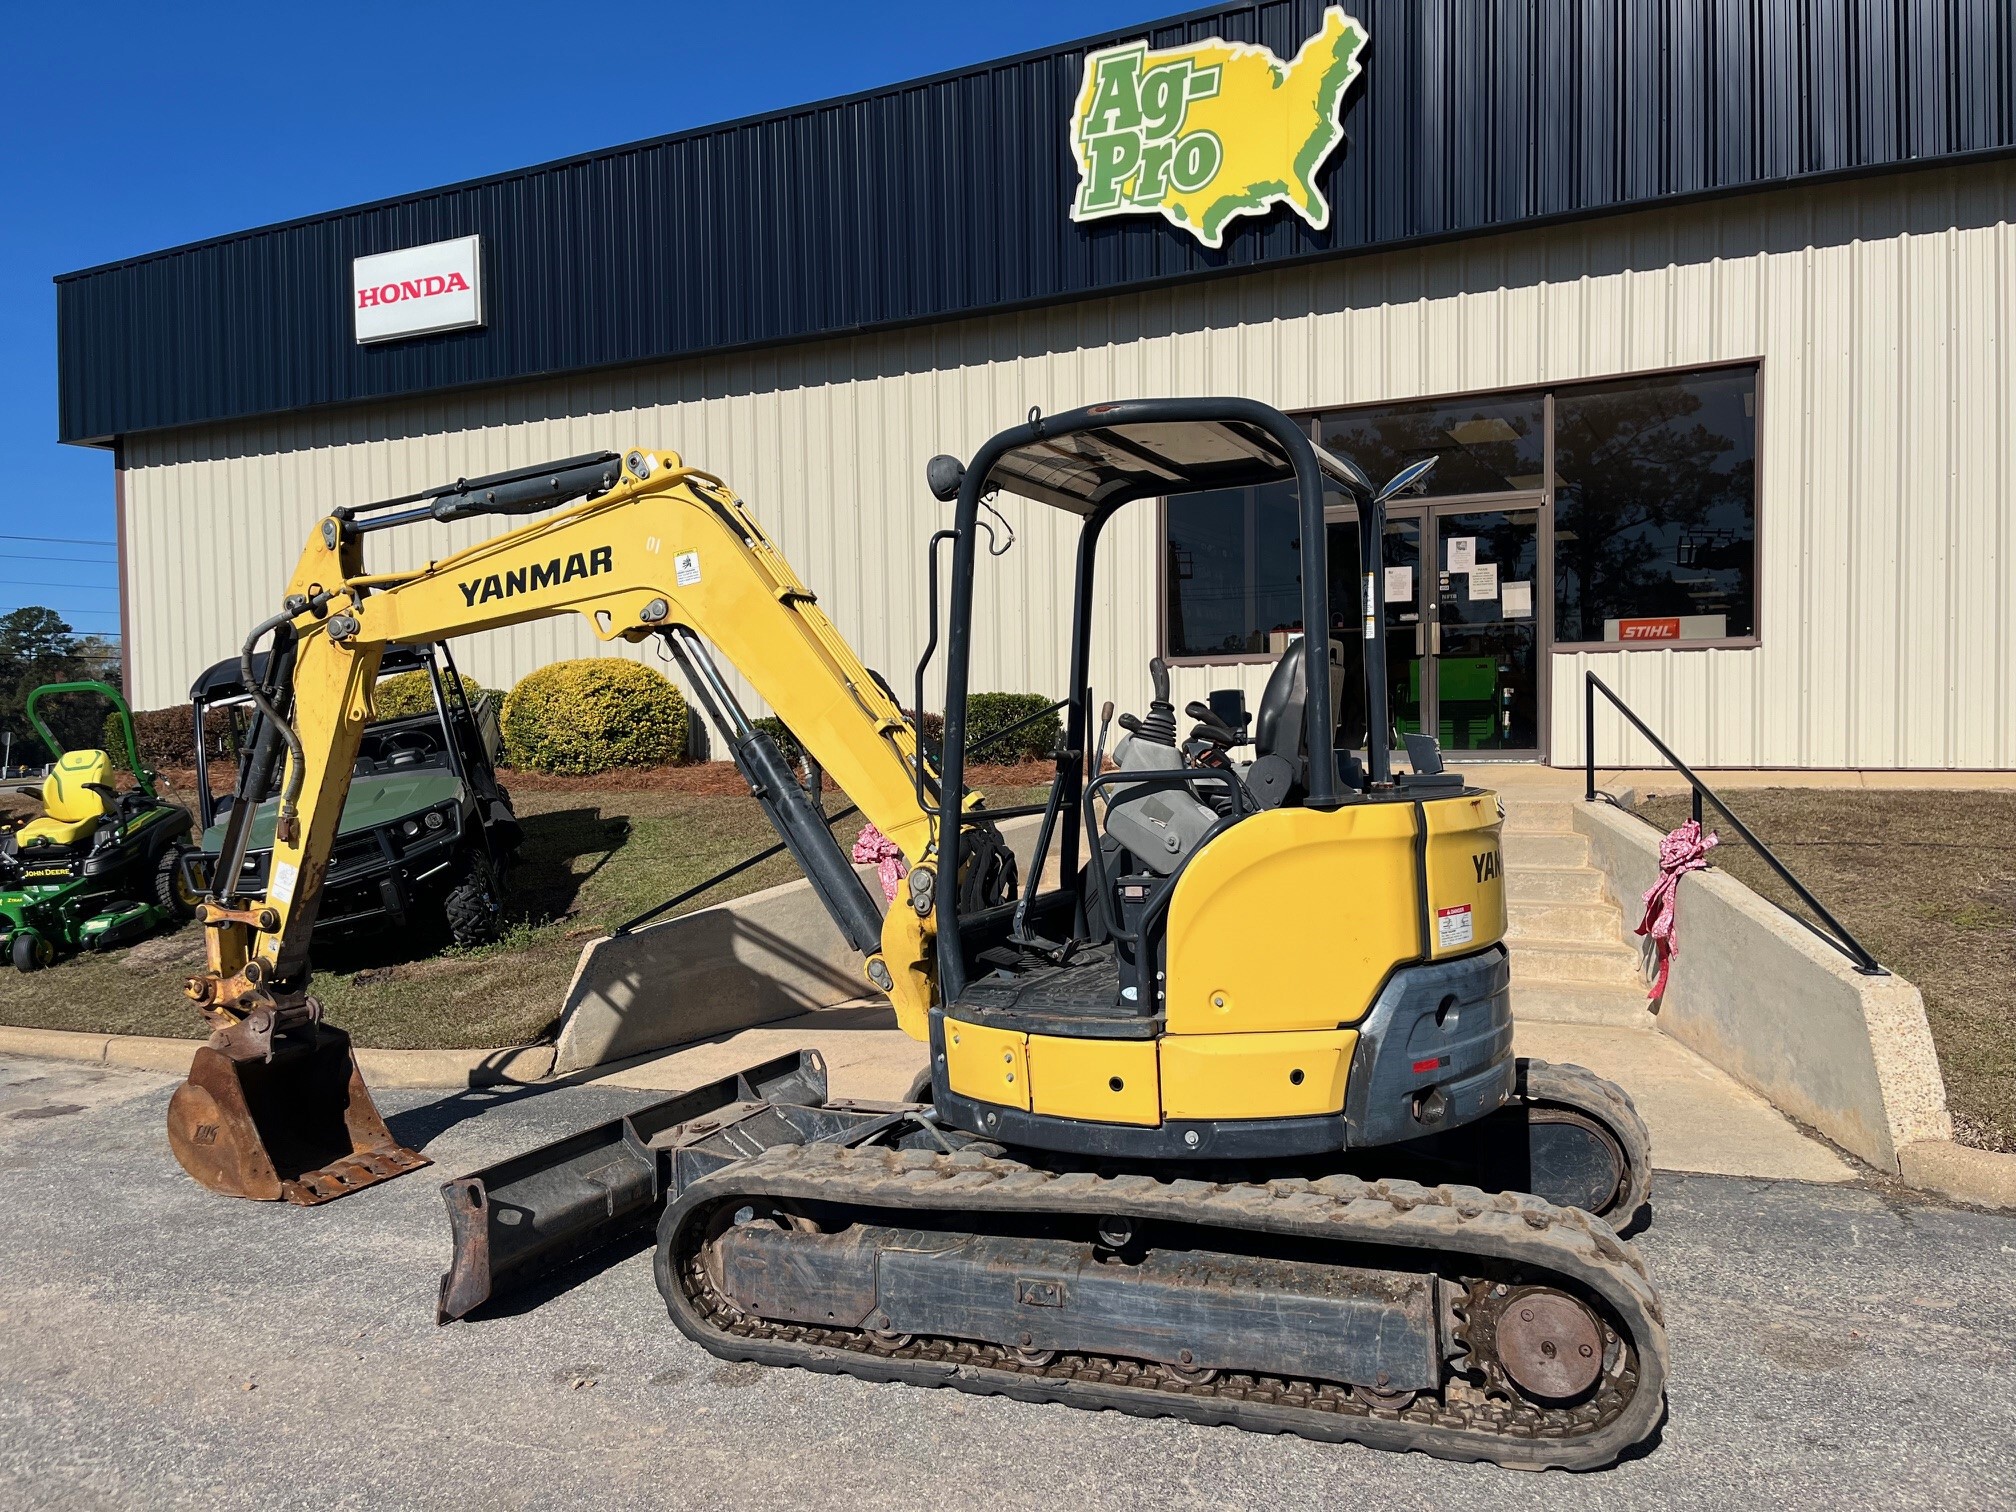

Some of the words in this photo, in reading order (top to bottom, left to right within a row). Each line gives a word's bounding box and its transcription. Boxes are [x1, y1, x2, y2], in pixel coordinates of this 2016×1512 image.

[1081, 48, 1222, 142] Ag-
[1081, 130, 1223, 213] Pro
[358, 272, 470, 309] HONDA
[458, 545, 612, 608] YANMAR
[1622, 625, 1673, 638] STIHL
[45, 868, 70, 876] DEERE
